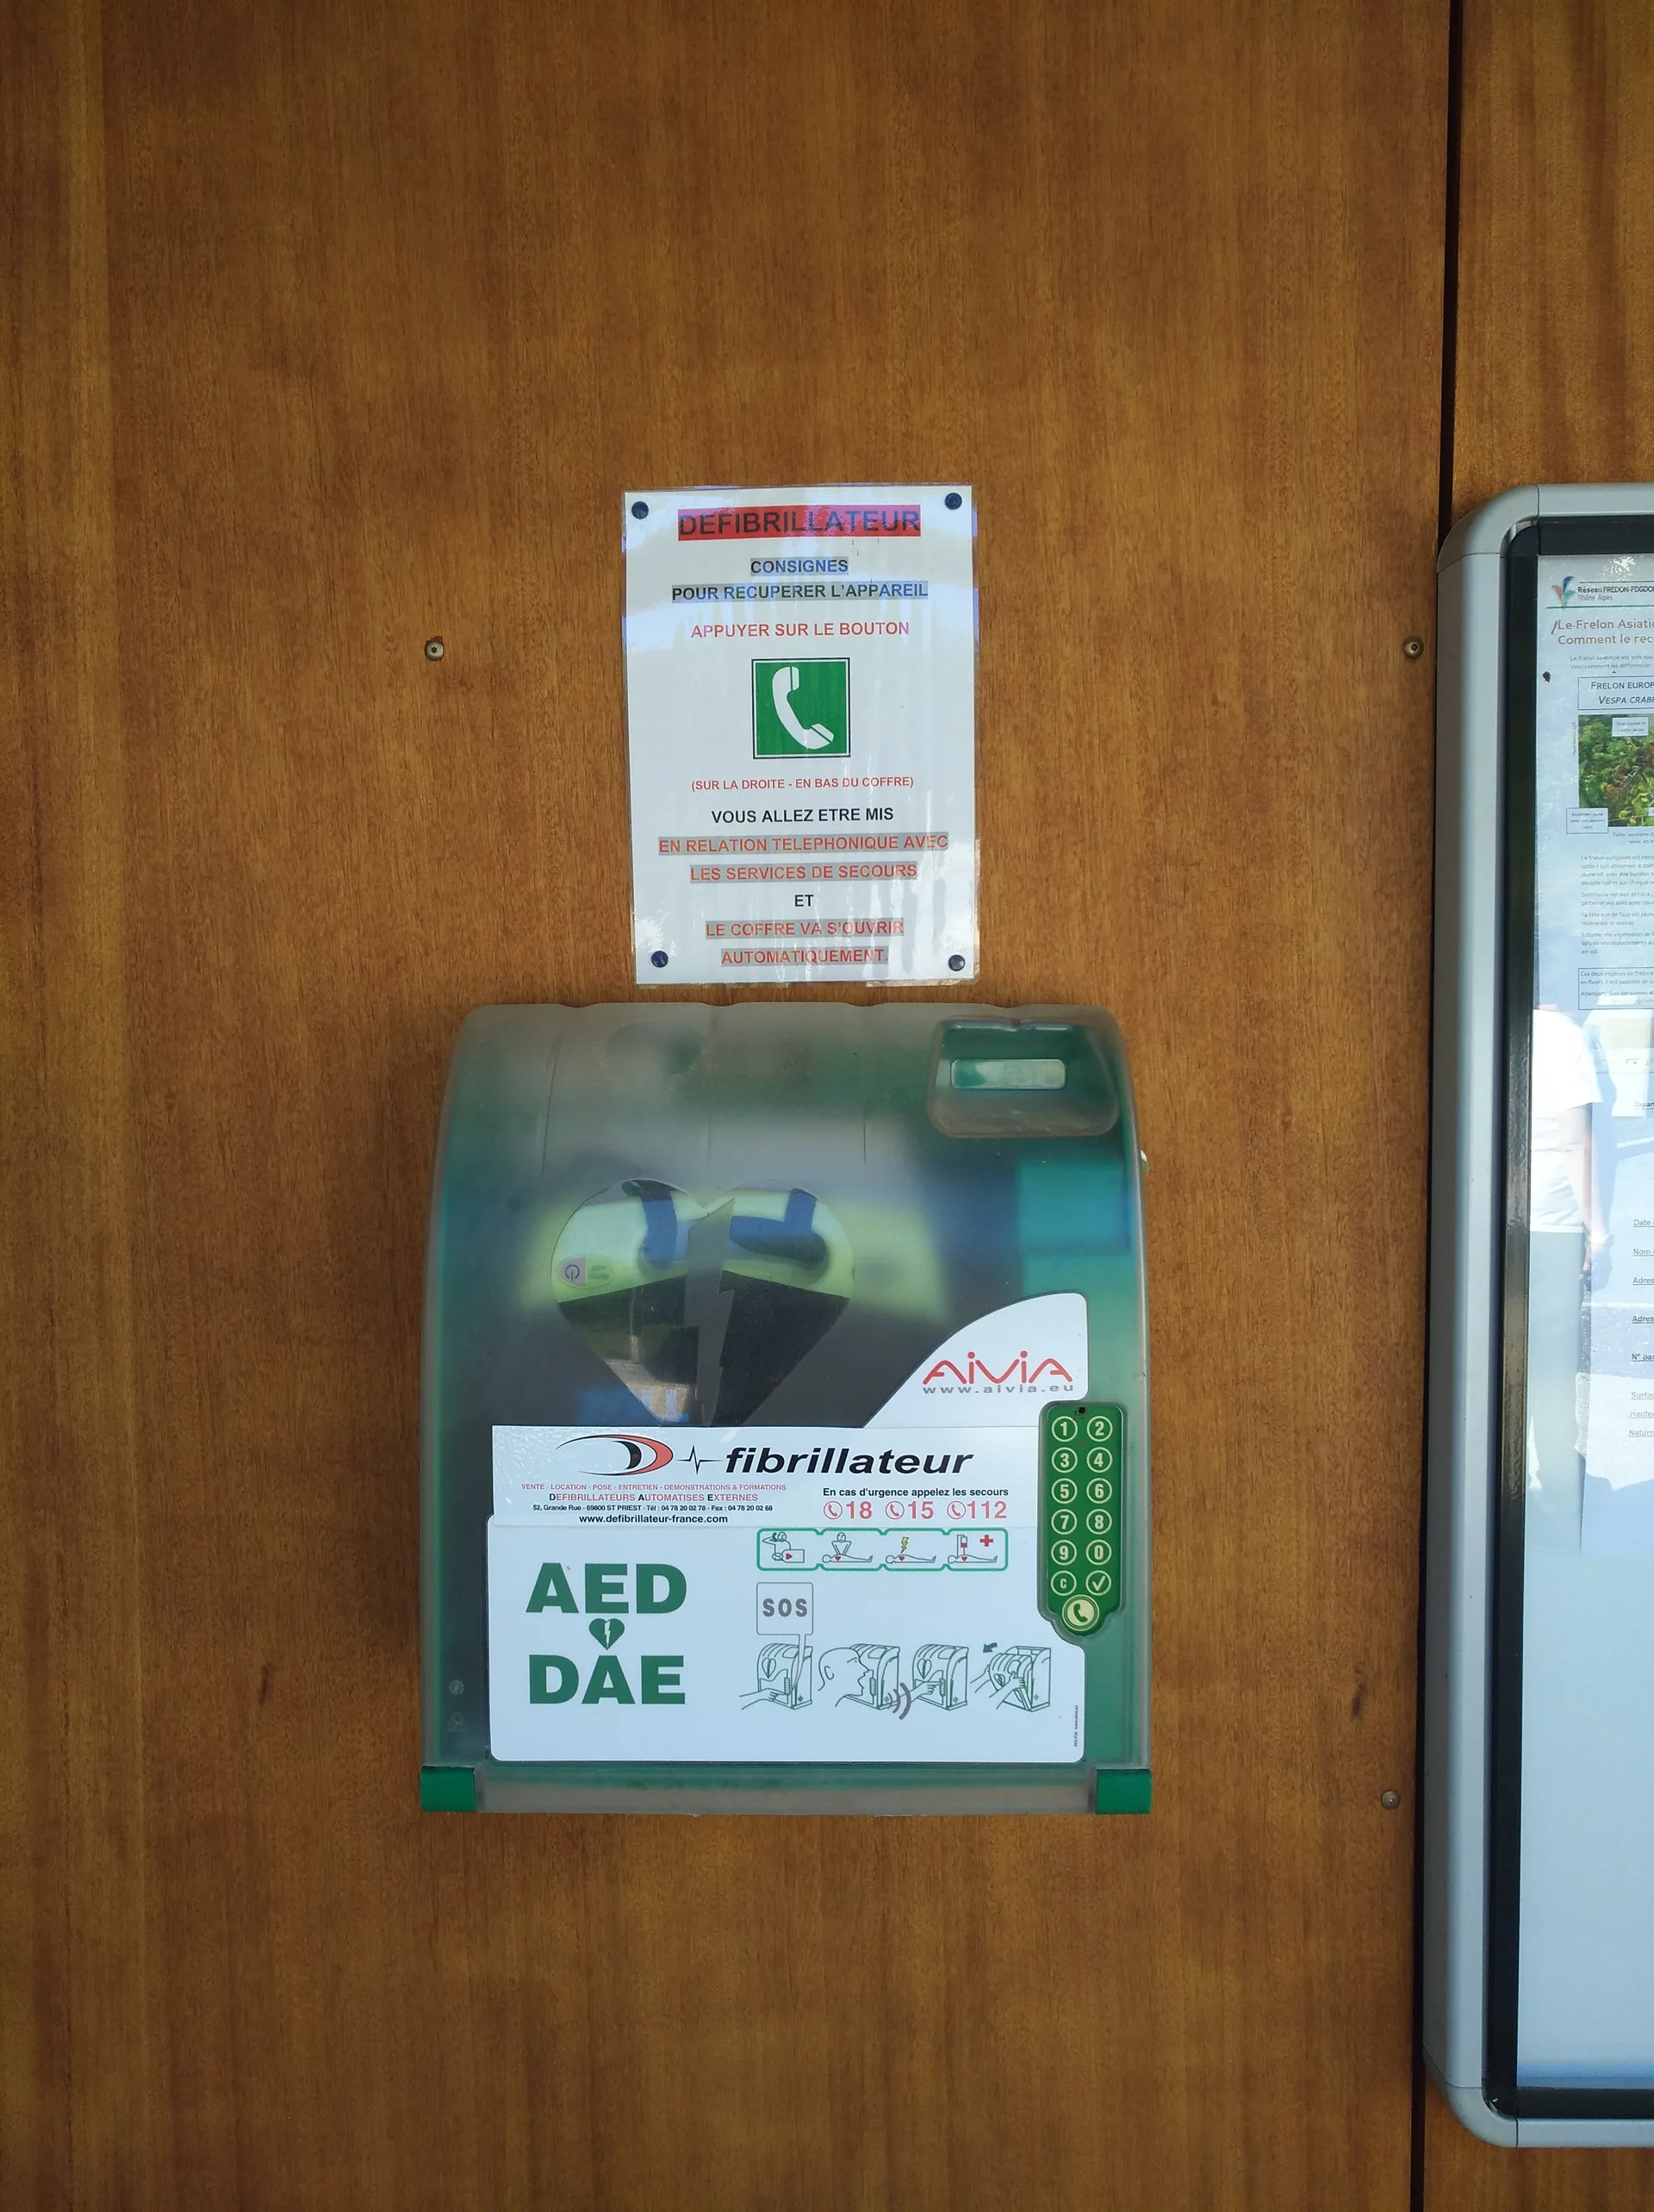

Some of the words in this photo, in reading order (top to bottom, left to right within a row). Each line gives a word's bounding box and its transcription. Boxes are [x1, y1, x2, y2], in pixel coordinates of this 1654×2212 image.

[680, 509, 921, 536] DEFIBRILLATEUR
[750, 559, 849, 574] CONSIGNES
[672, 587, 719, 601] POUR
[724, 585, 826, 600] RECUPERER
[831, 583, 929, 598] L'APPAREIL
[691, 623, 771, 639] APPUYER
[774, 622, 809, 638] SUR
[814, 622, 834, 637] LE
[839, 621, 910, 636] BOUTON
[1576, 620, 1614, 629] Frelon
[1558, 635, 1616, 645] Comment
[1620, 634, 1631, 644] le
[1634, 635, 1654, 644] rec
[692, 779, 720, 793] (SUR
[723, 779, 739, 790] LA
[742, 778, 785, 789] DROITE
[796, 778, 811, 788] EN
[814, 777, 839, 788] BAS
[843, 777, 859, 788] DU
[861, 776, 913, 789] COFFRE)
[712, 810, 756, 824] VOUS
[762, 809, 814, 823] ALLEZ
[818, 808, 861, 822] ETRE
[866, 807, 893, 821] MIS
[659, 838, 681, 853] EN
[686, 838, 768, 853] RELATION
[772, 836, 899, 852] TELEPHONIQUE
[904, 835, 948, 850] AVEC
[691, 866, 721, 881] LES
[726, 865, 806, 880] SERVICES
[812, 865, 833, 878] DE
[838, 863, 918, 878] SECOURS
[794, 894, 814, 908] ET
[706, 923, 726, 937] LE
[731, 922, 795, 937] COFFRE
[800, 921, 822, 935] VA
[827, 920, 904, 935] S'OUVRIR
[722, 949, 888, 965] AUTOMATIQUEMENT.
[923, 1384, 1073, 1394] www.aivia.eu
[1060, 1422, 1067, 1436] 1
[1095, 1422, 1104, 1436] 2
[725, 1447, 973, 1474] fibrillateur
[1060, 1453, 1069, 1467] 3
[1094, 1452, 1104, 1467] 4
[859, 1488, 909, 1498] d'urgence
[911, 1488, 949, 1498] appelez
[1060, 1484, 1069, 1499] 5
[1094, 1484, 1104, 1499] 6
[846, 1500, 873, 1519] 18
[908, 1500, 934, 1519] 15
[967, 1500, 1007, 1519] 112
[1060, 1515, 1069, 1530] 7
[1094, 1515, 1104, 1530] 8
[1059, 1546, 1069, 1560] 9
[1094, 1545, 1104, 1560] 0
[525, 1562, 687, 1614] AED
[762, 1598, 808, 1617] SOS
[529, 1654, 686, 1704] DAE
